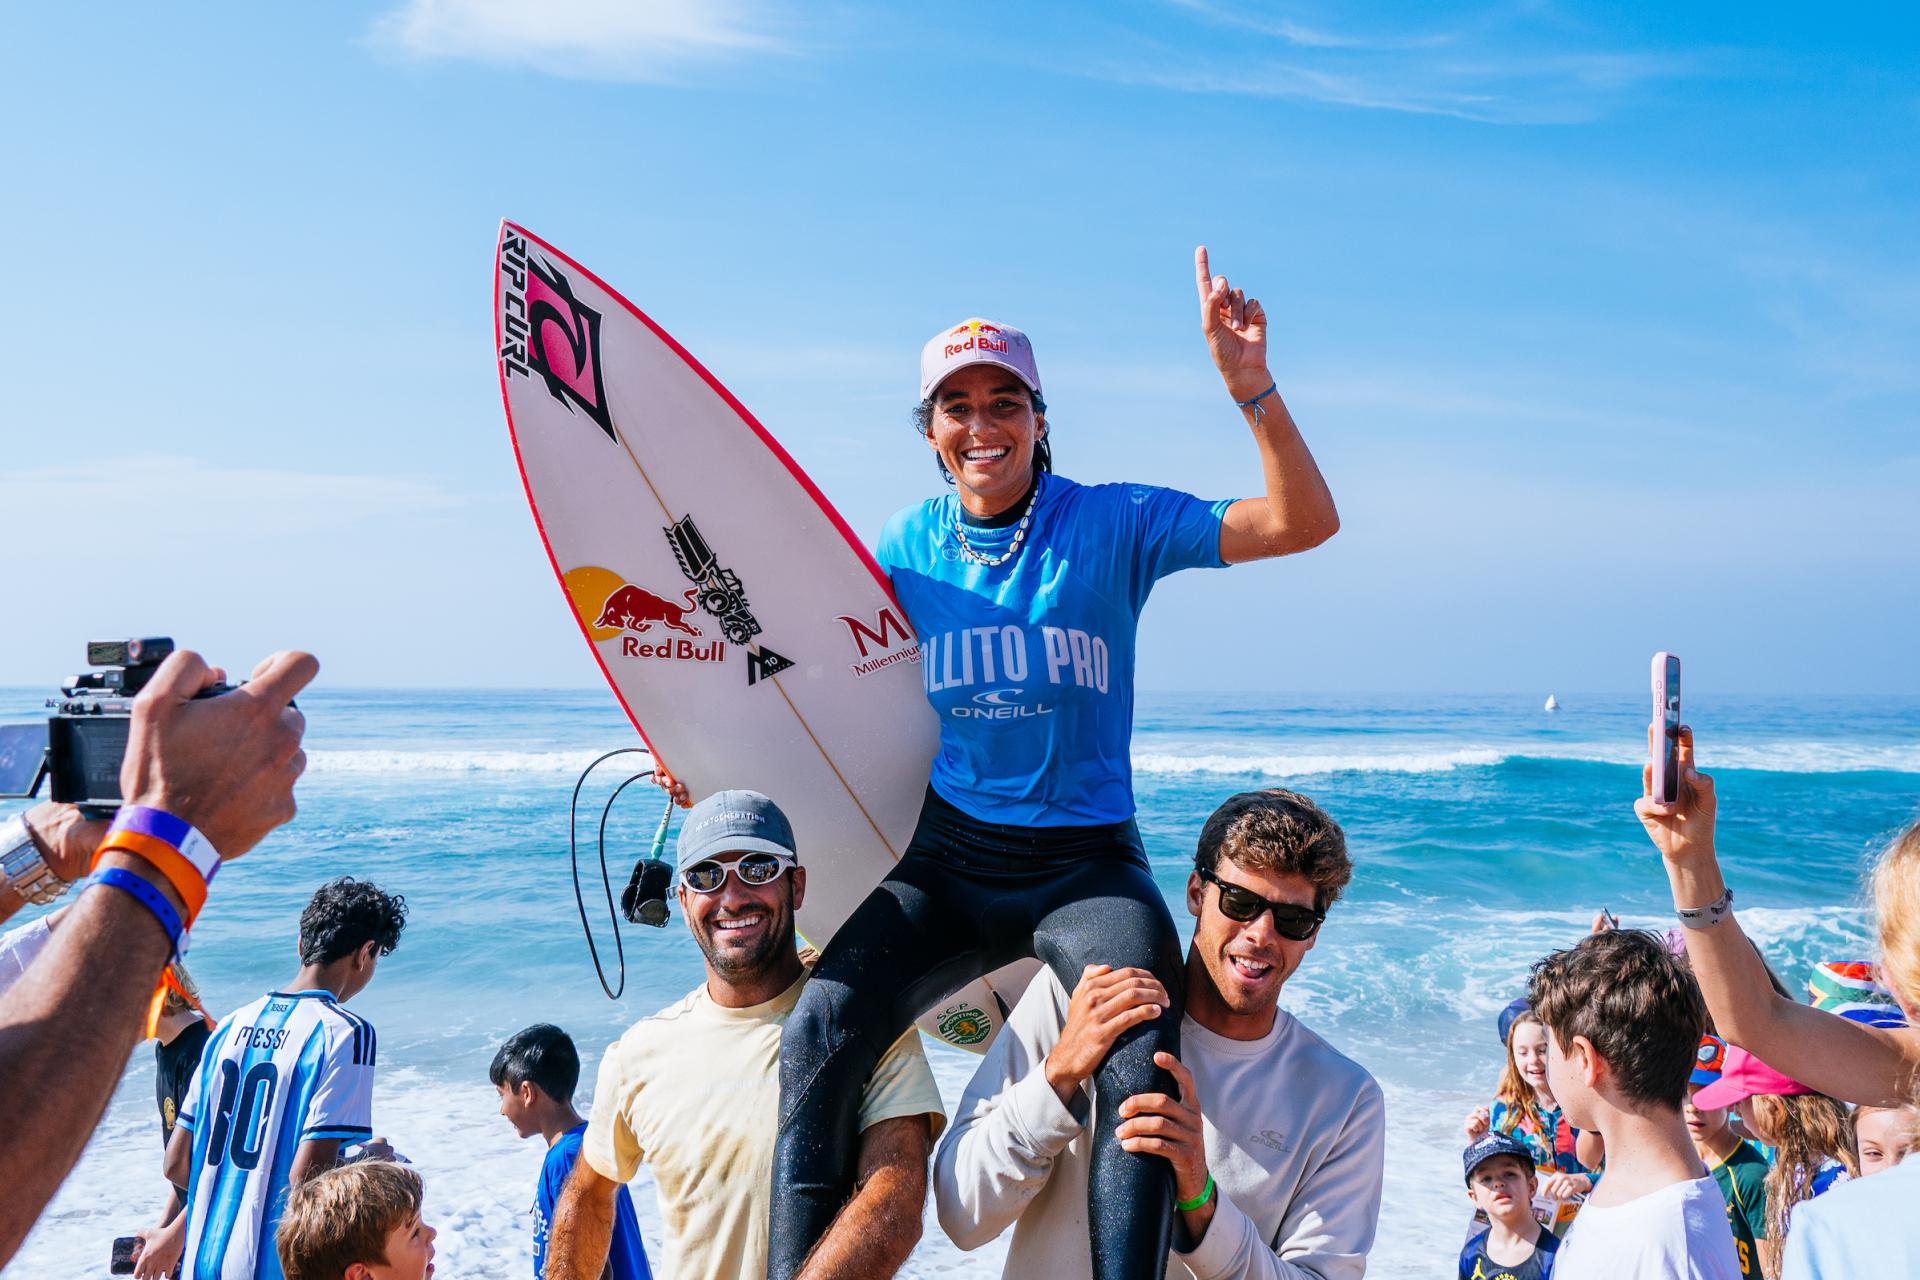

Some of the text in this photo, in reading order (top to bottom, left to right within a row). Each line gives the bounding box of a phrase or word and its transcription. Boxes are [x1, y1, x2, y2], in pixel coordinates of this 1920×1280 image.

[501, 229, 529, 378] RIP CURL
[944, 337, 1009, 359] Red Bull
[622, 638, 725, 662] Red Bull
[764, 656, 778, 667] 10
[1042, 626, 1109, 695] PRO
[951, 703, 1053, 720] O'NEILL
[936, 1002, 969, 1020] SCP
[234, 1025, 291, 1050] MESSI
[207, 1058, 278, 1171] 10
